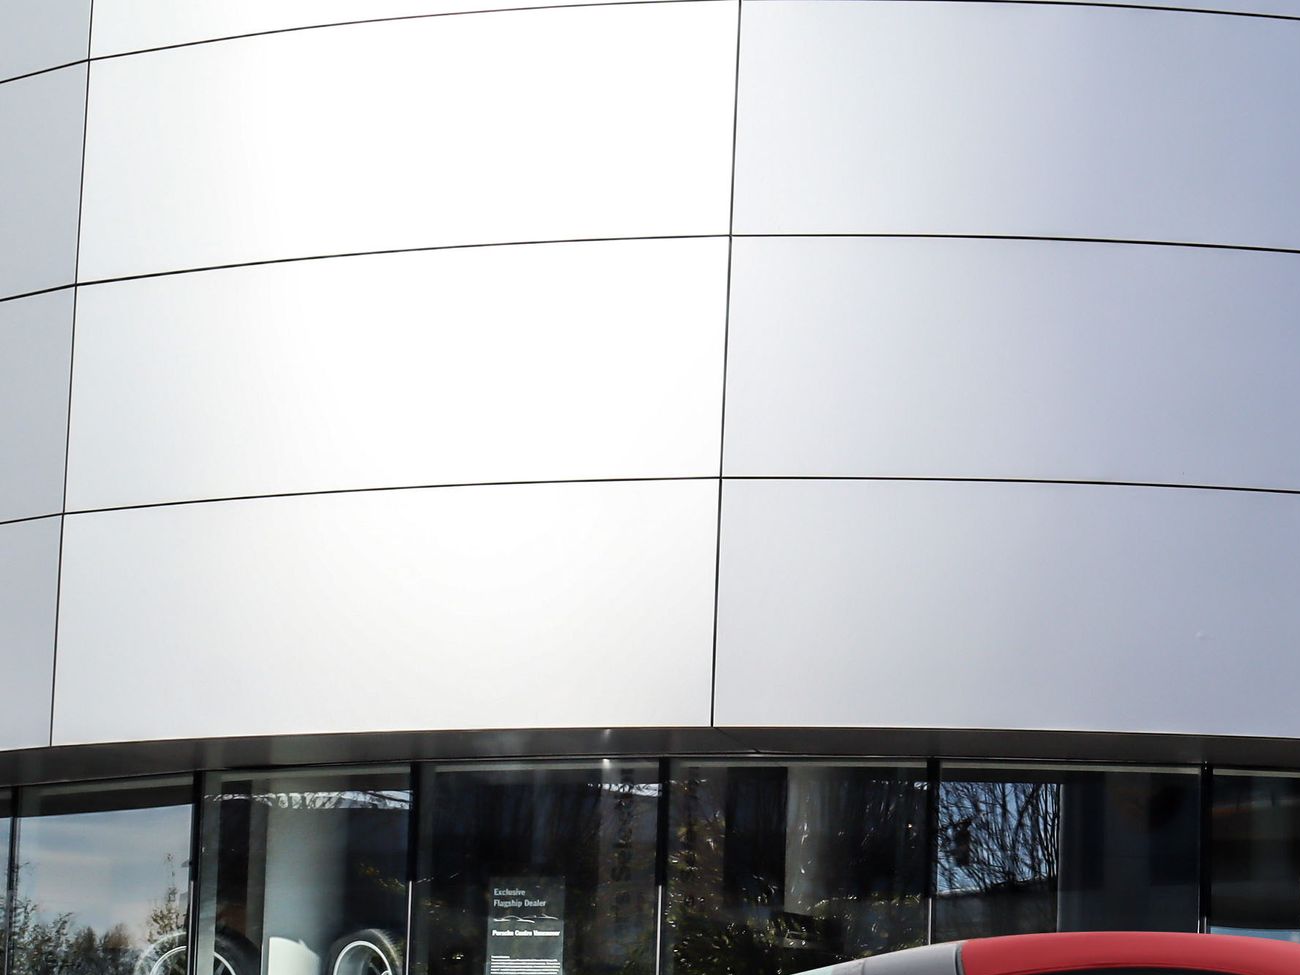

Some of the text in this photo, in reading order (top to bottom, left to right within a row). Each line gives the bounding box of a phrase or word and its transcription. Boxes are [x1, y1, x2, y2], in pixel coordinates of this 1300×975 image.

[493, 888, 526, 896] Exclusive
[493, 899, 546, 908] Flagship Dealer
